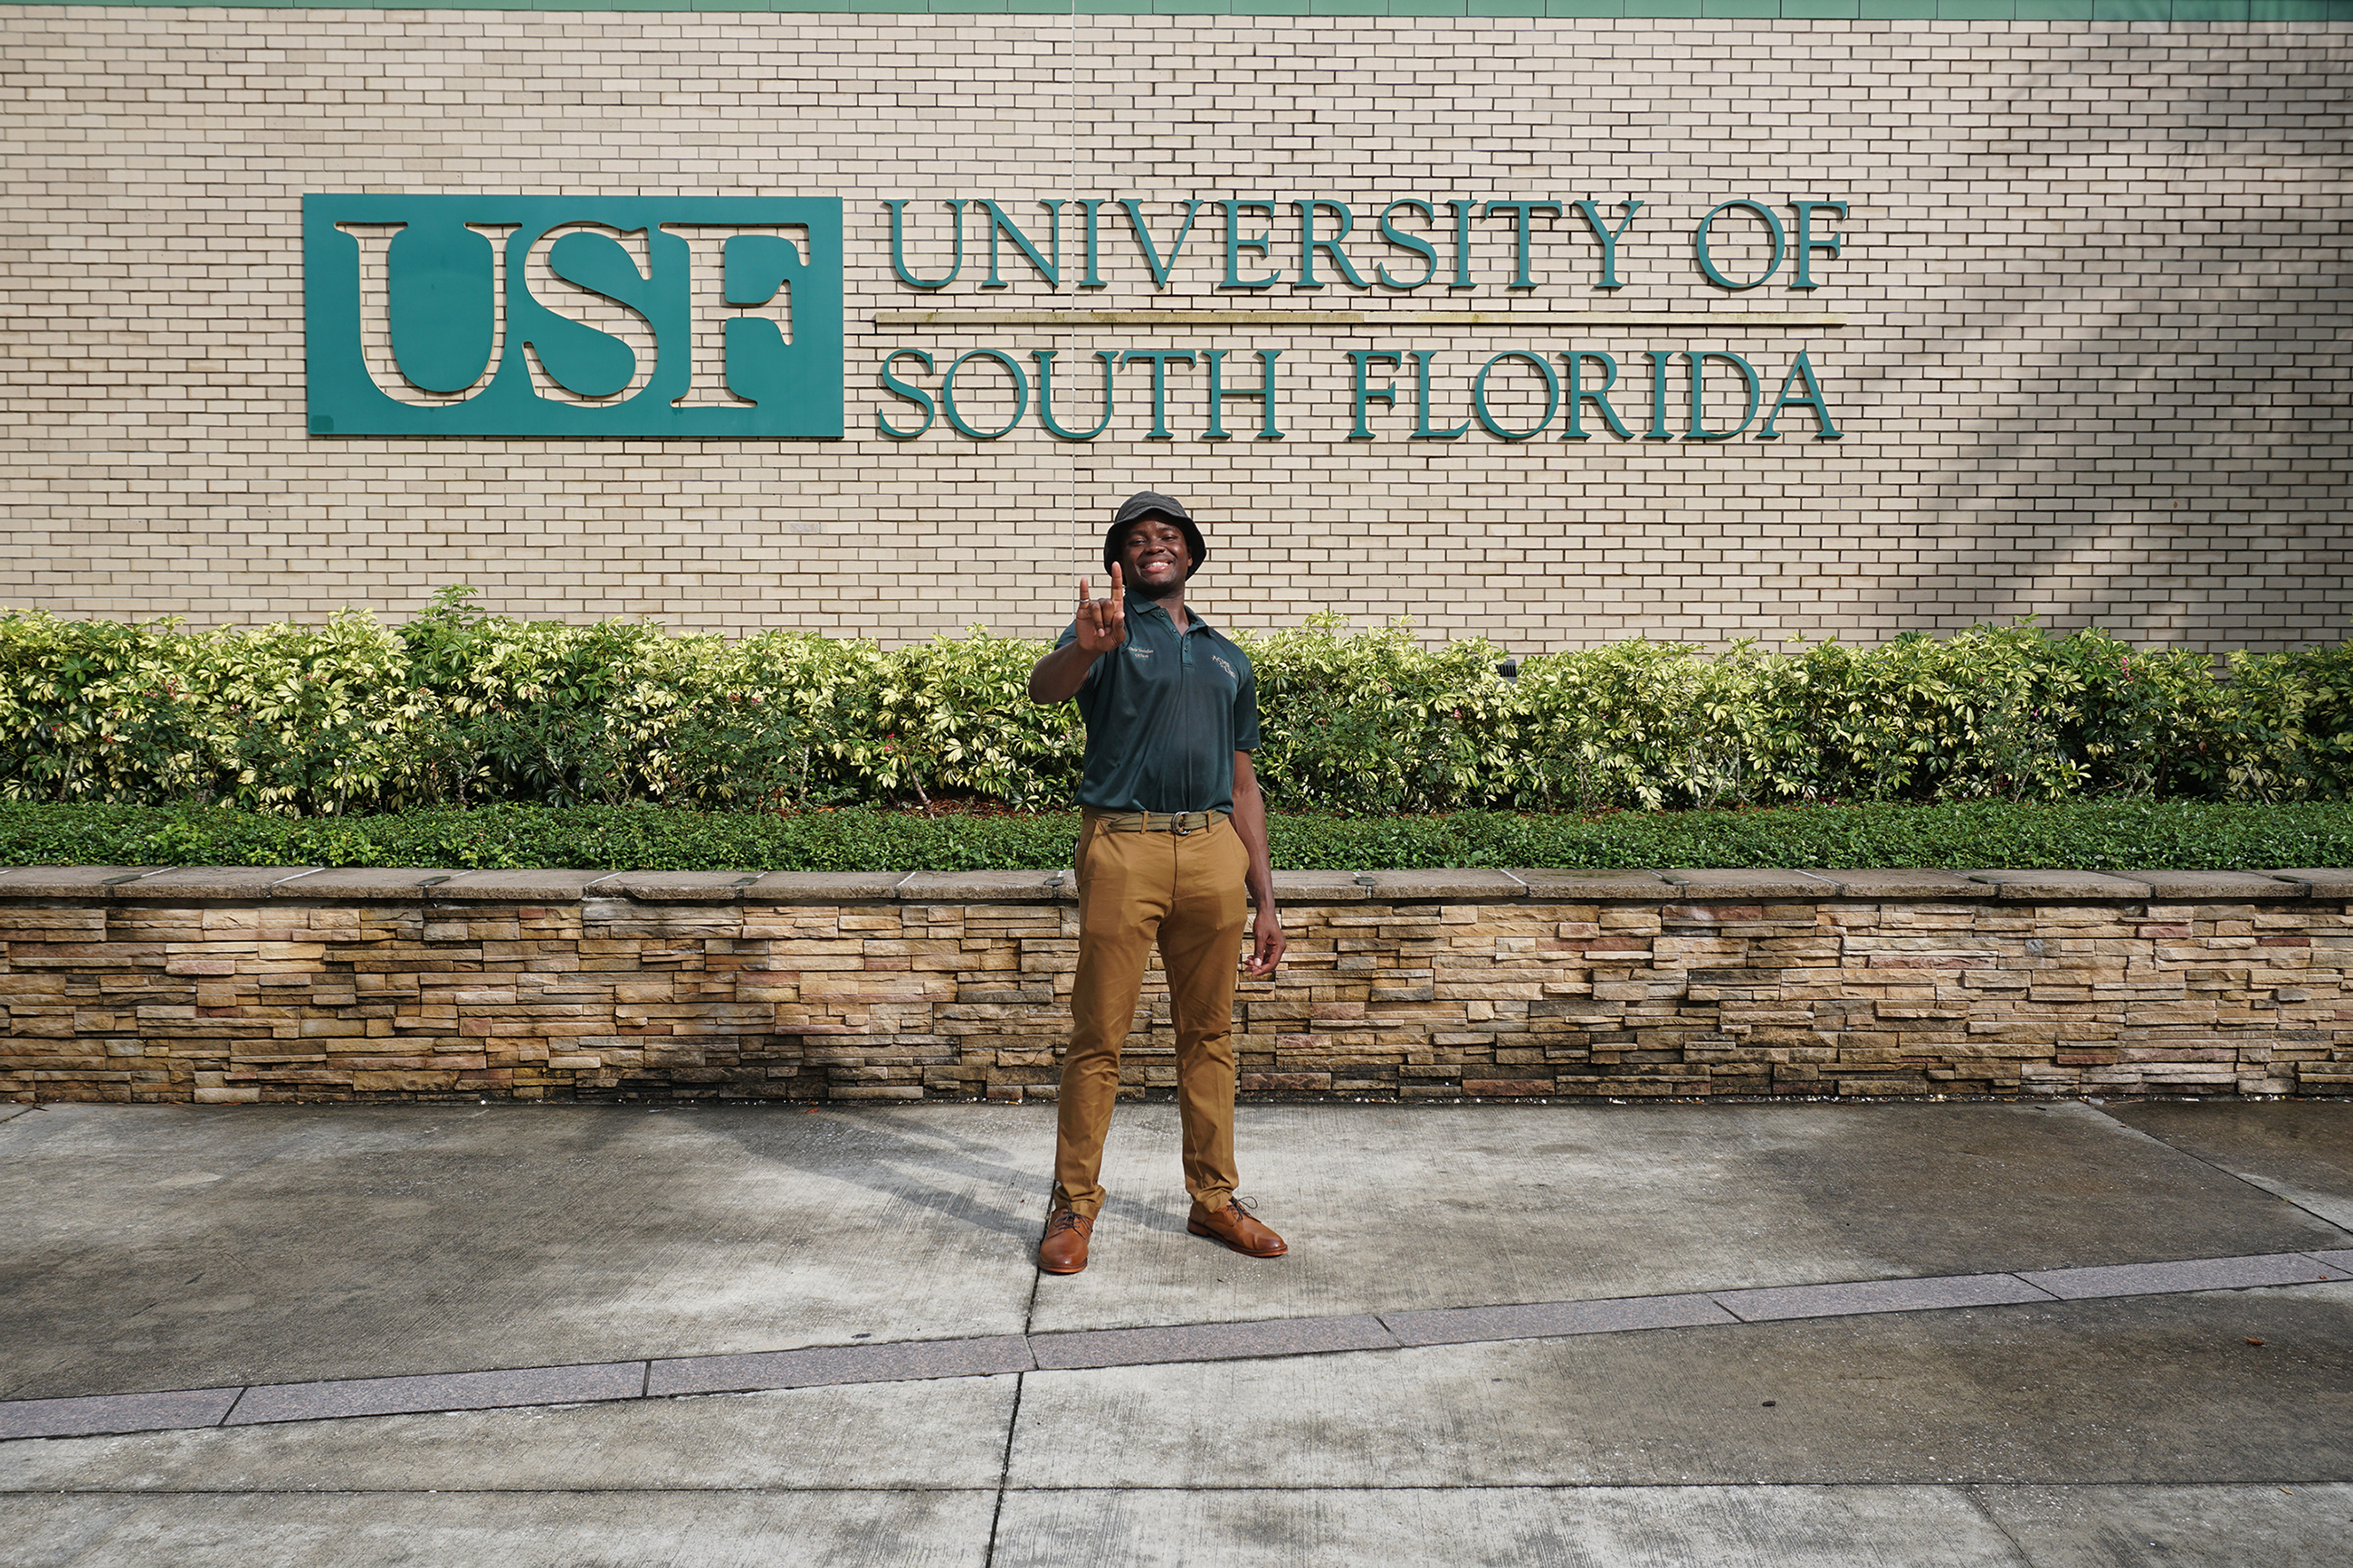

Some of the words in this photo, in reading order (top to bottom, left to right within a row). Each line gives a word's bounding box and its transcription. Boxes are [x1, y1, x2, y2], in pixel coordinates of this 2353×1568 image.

[884, 199, 1643, 287] UNIVERSITY
[1698, 200, 1847, 287] OF
[333, 220, 811, 408] USF
[880, 349, 1285, 438] SOUTH
[1348, 349, 1843, 437] FLORIDA
